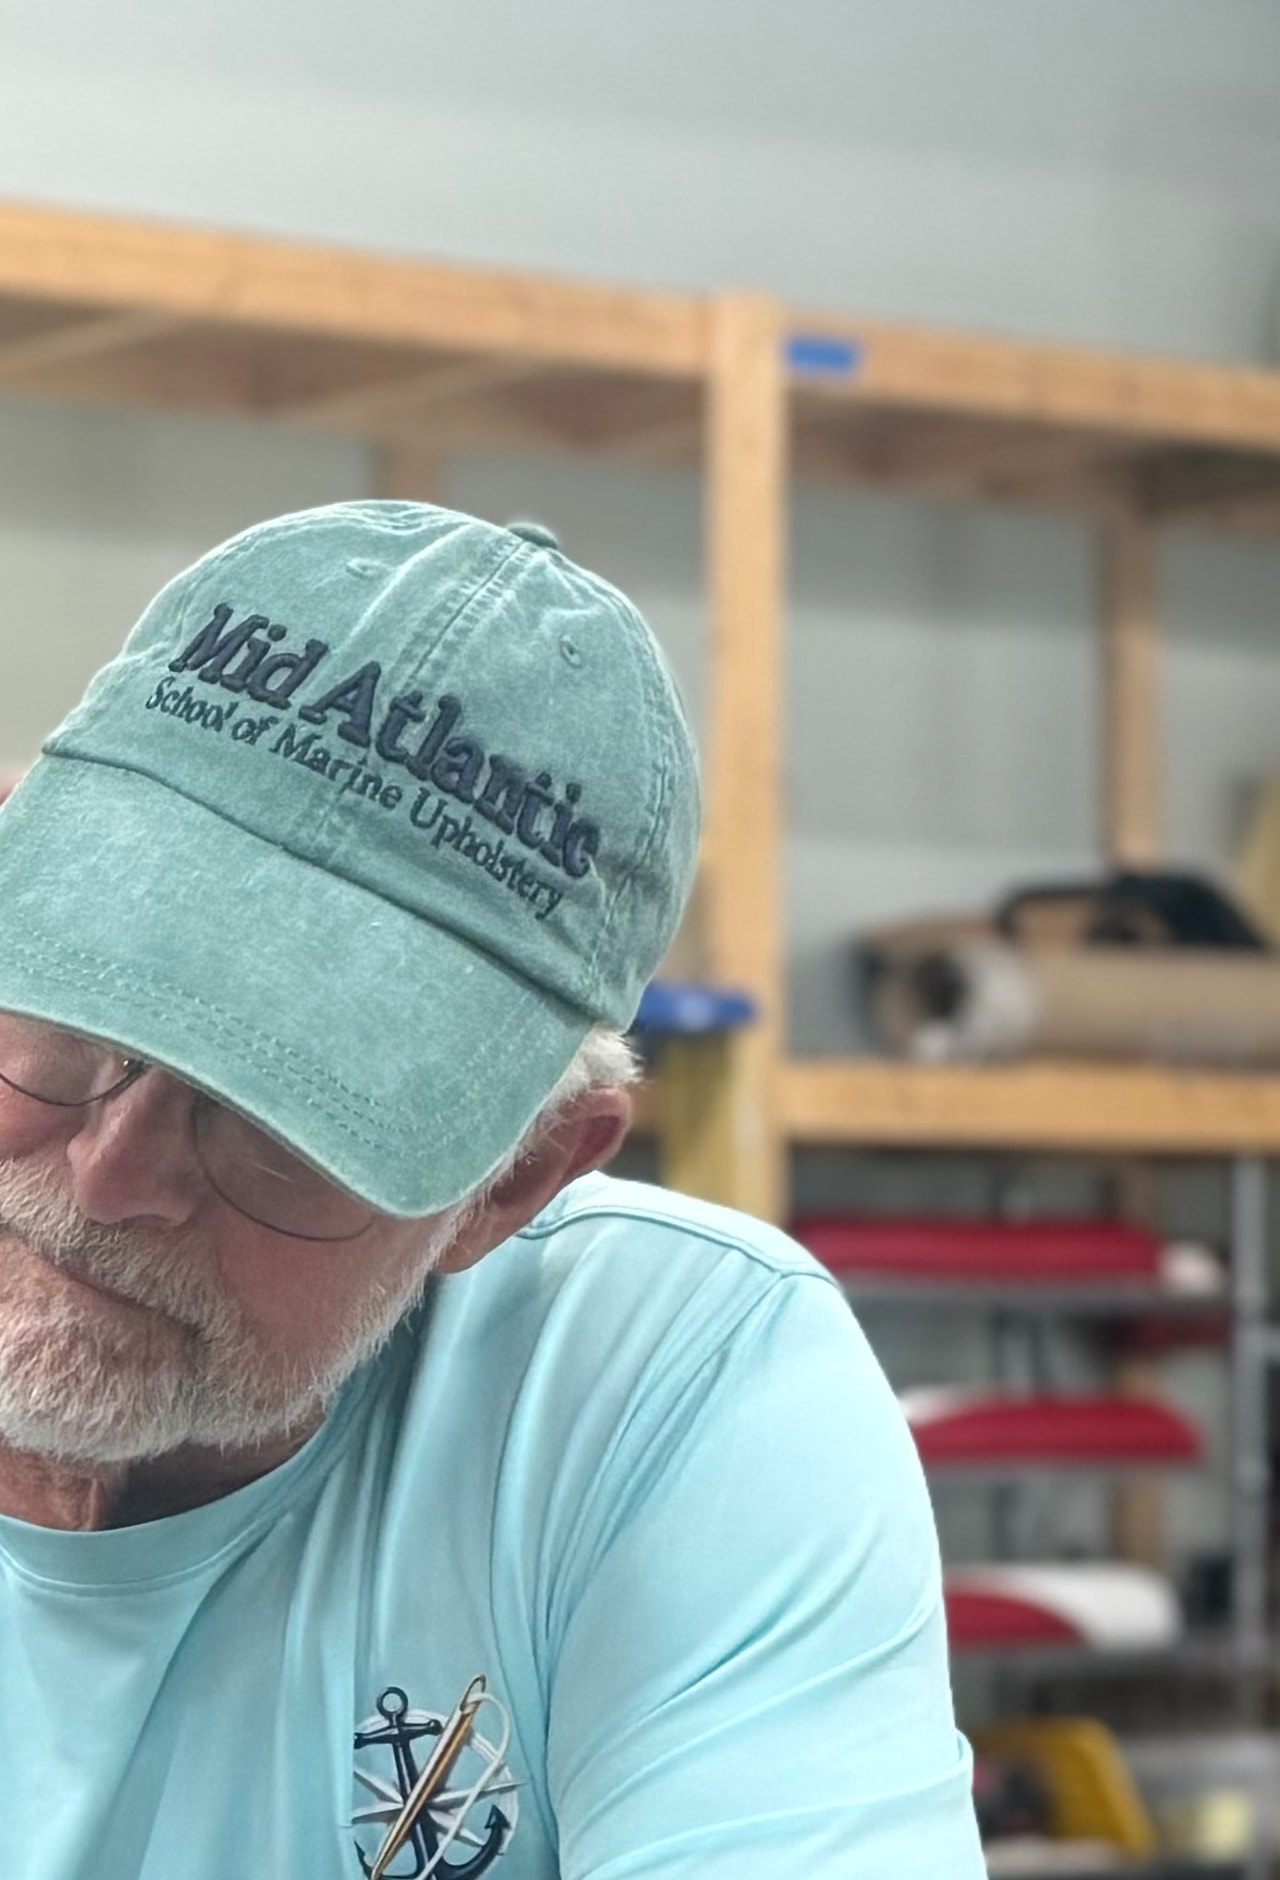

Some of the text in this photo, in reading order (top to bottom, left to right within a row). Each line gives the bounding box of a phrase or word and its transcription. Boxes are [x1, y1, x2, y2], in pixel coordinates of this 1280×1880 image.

[145, 676, 565, 920] School of Marine Upholstery
[168, 602, 601, 878] Mid Atlantic
